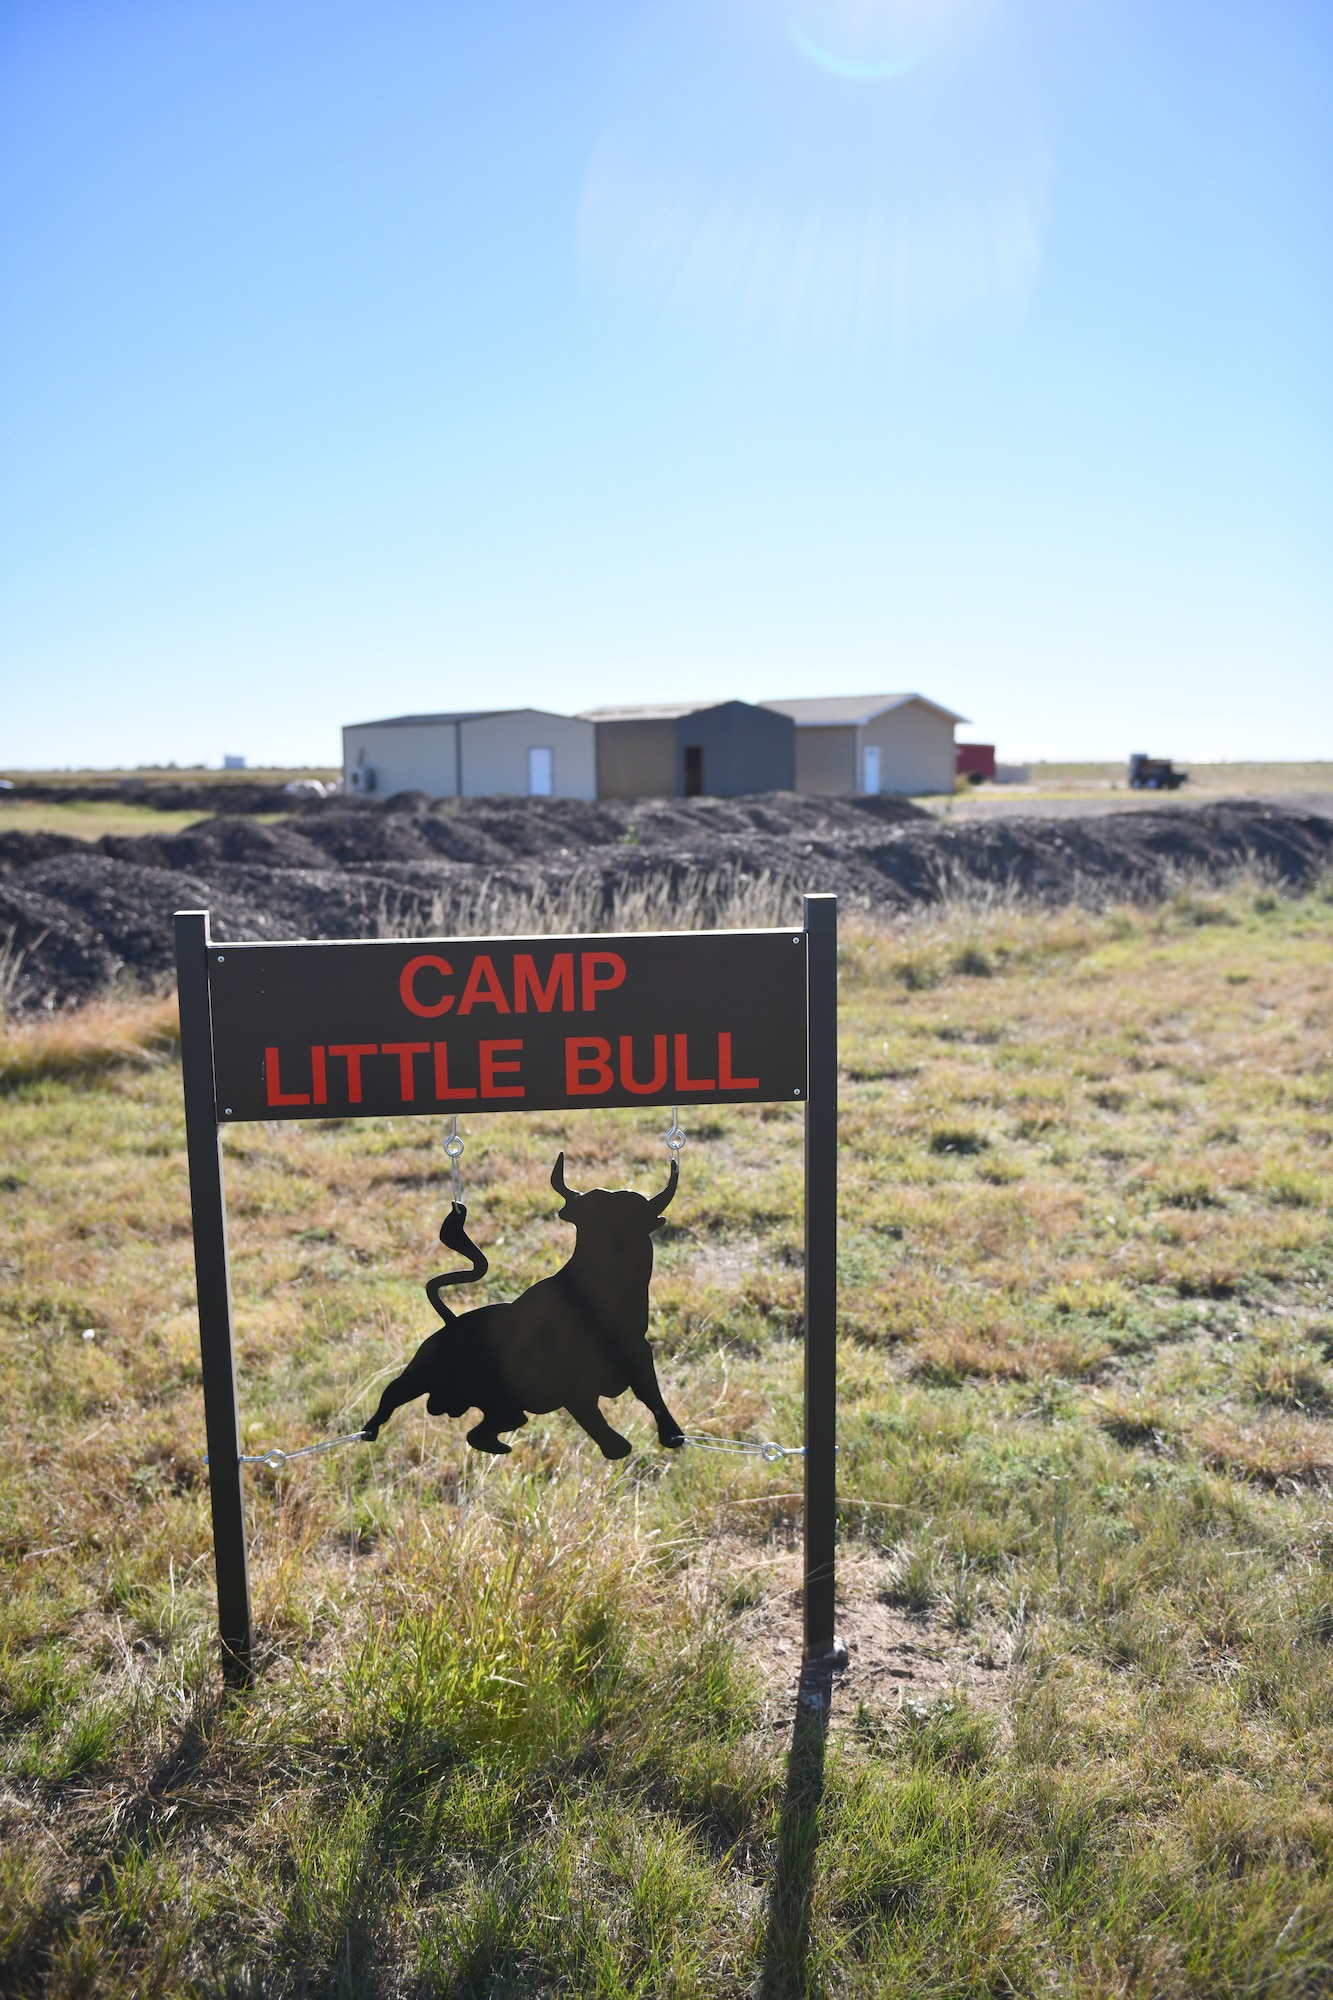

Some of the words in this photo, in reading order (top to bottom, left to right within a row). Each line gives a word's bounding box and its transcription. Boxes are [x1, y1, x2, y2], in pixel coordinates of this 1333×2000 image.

[400, 952, 626, 1017] CAMP
[265, 1039, 525, 1106] LITTLE
[565, 1032, 759, 1094] BULL
